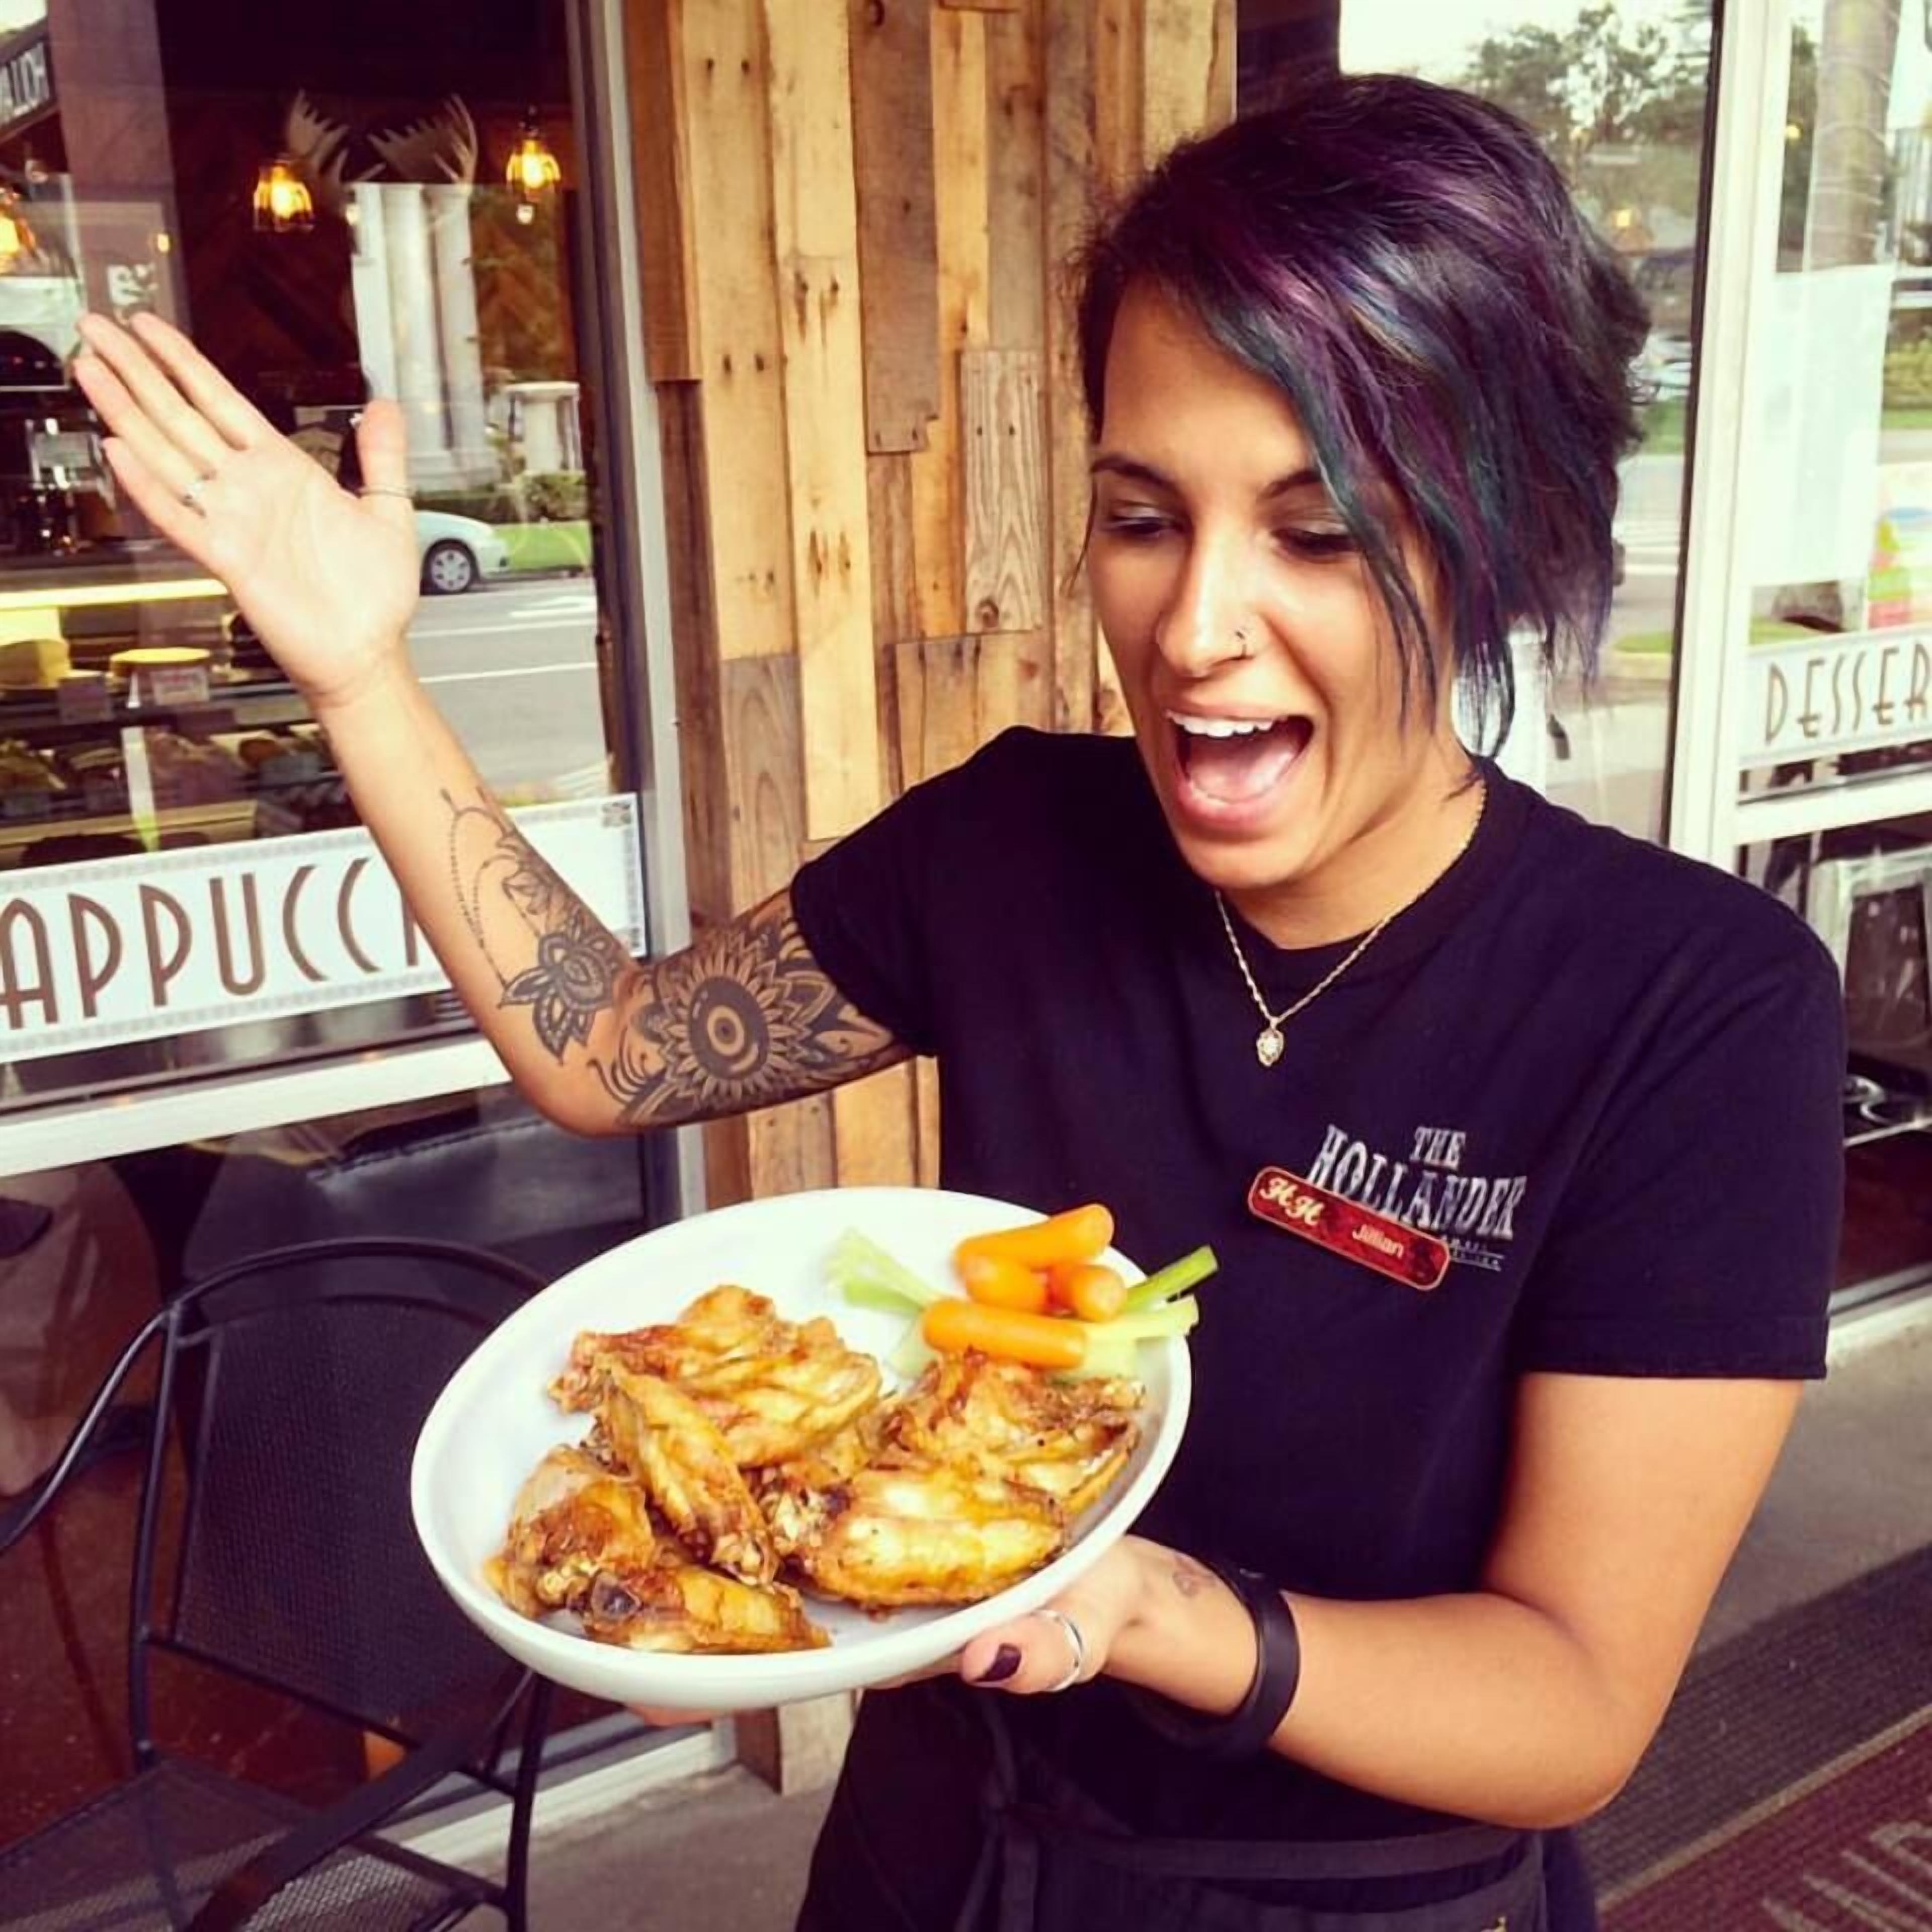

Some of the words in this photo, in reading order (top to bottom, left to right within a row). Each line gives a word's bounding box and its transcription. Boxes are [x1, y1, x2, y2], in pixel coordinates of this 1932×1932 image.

[1409, 1126, 1466, 1170] THE
[1307, 1123, 1527, 1240] HOLLANDER
[1352, 1224, 1404, 1259] Jillian
